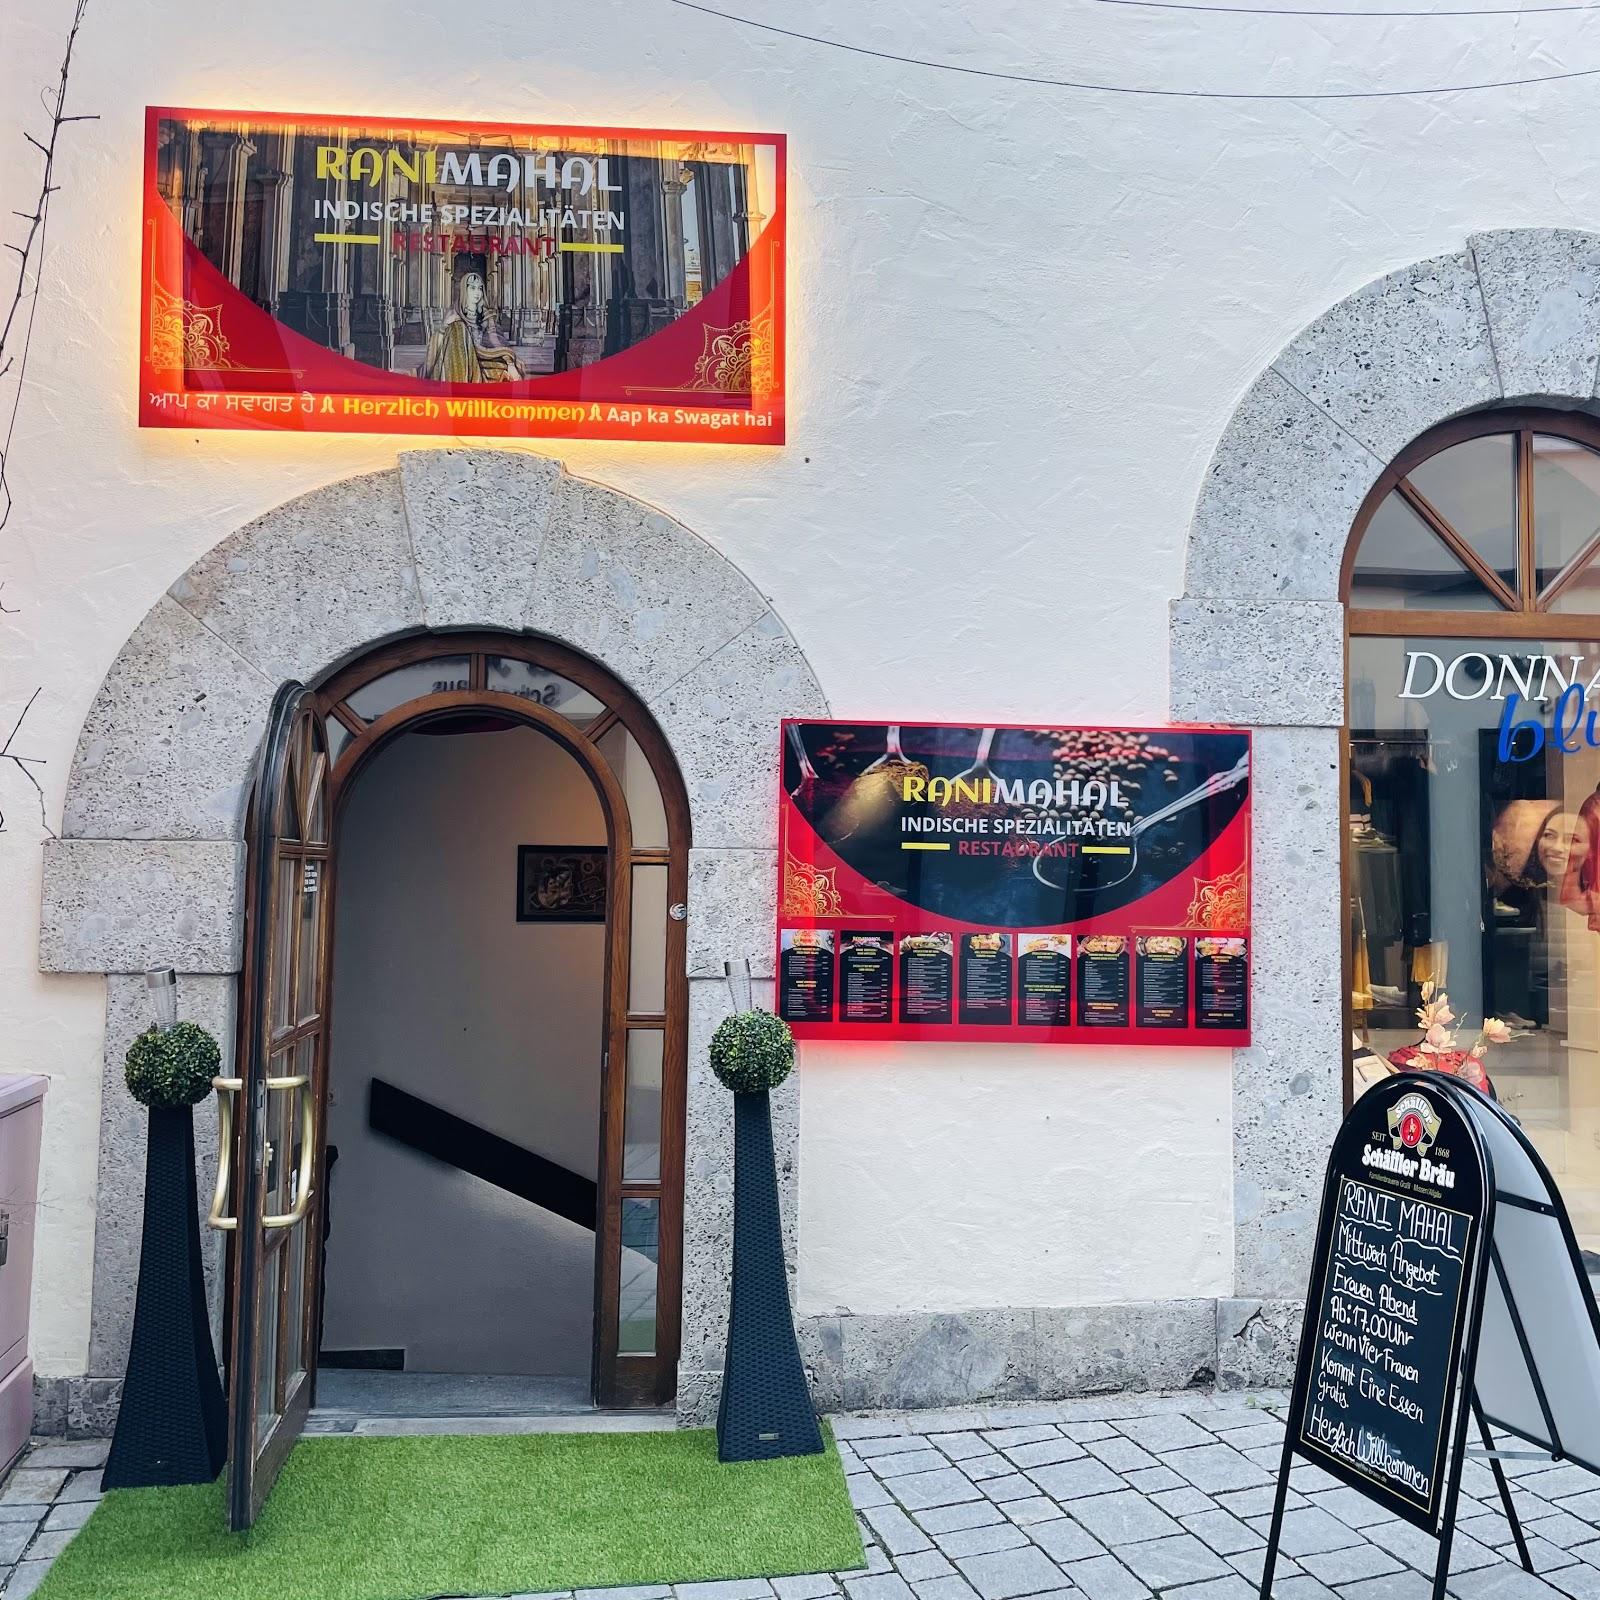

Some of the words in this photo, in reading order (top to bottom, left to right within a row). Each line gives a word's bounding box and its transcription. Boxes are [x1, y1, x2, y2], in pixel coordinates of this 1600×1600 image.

[314, 199, 433, 223] INDISCHE
[441, 204, 625, 231] SPEZIALITÄTEN
[393, 230, 555, 256] RESTAURANT
[343, 398, 439, 419] Herzlich
[446, 400, 586, 423] Willkommen
[606, 407, 643, 426] Aap
[648, 408, 669, 424] ka
[674, 409, 740, 429] Swagat
[745, 411, 773, 427] hai
[901, 816, 989, 834] INDISCHE
[993, 818, 1131, 837] SPEZIALITÄTEN
[958, 840, 1079, 858] RESTAURANT
[1362, 1144, 1418, 1177] Schäffler
[1418, 1155, 1455, 1189] Bräu
[1371, 1130, 1387, 1143] SEIT
[1434, 1146, 1451, 1159] 1868
[1344, 1181, 1395, 1226] RANI
[1399, 1200, 1460, 1254] MAHAL
[1337, 1221, 1388, 1268] Mittwoch
[1390, 1241, 1440, 1287] Angebot
[1333, 1262, 1375, 1303] Frauen
[1379, 1284, 1417, 1319] Abend
[1323, 1320, 1357, 1353] Wenn
[1383, 1347, 1420, 1384] Frauen
[1320, 1345, 1356, 1387] Kommt
[1359, 1368, 1387, 1407] Eine
[1389, 1383, 1424, 1424] Essen
[1309, 1404, 1356, 1453] Herzlich
[1357, 1427, 1429, 1492] Willkommen
